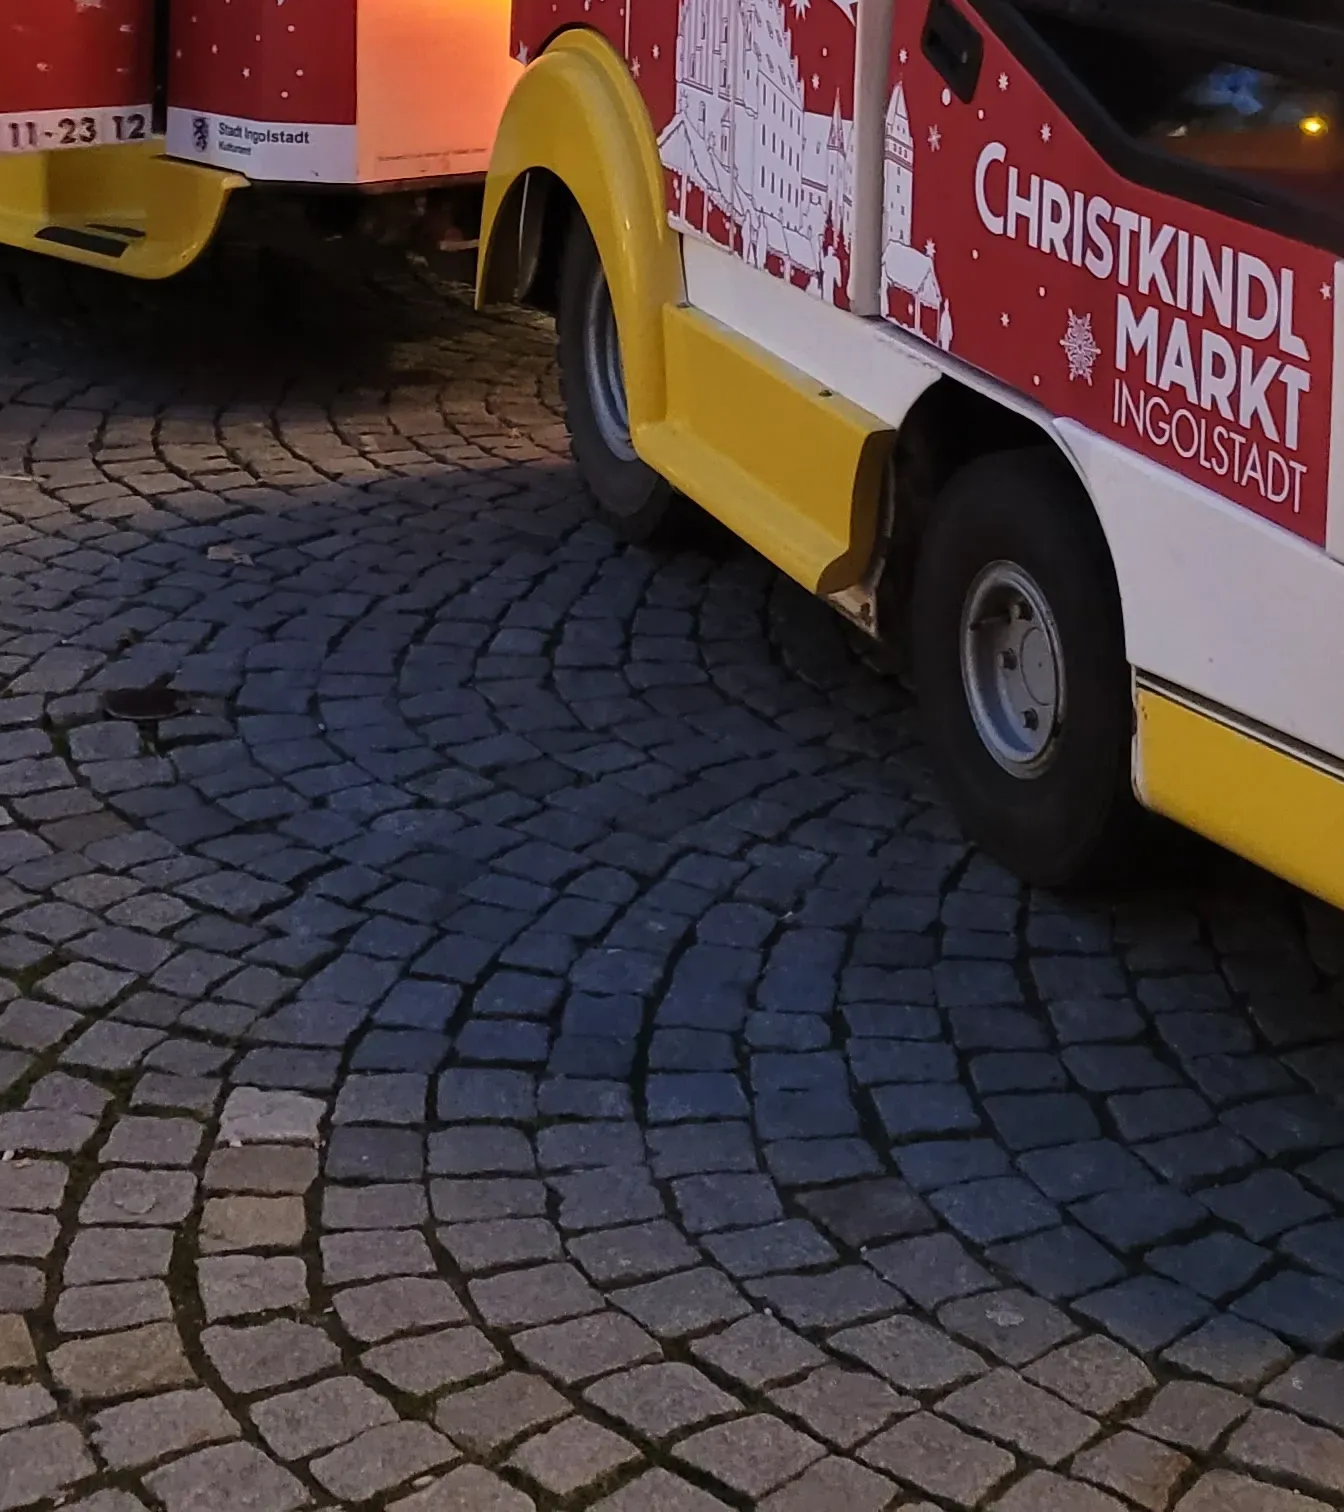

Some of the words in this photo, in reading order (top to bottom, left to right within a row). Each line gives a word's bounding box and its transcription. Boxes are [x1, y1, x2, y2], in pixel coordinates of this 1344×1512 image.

[112, 113, 146, 140] 12
[218, 122, 242, 138] Stadt
[244, 127, 310, 145] Ingolstadt
[975, 142, 1310, 361] CHRISTKINDL
[1115, 293, 1311, 451] MARKT
[1113, 378, 1308, 513] INGOLSTADT
